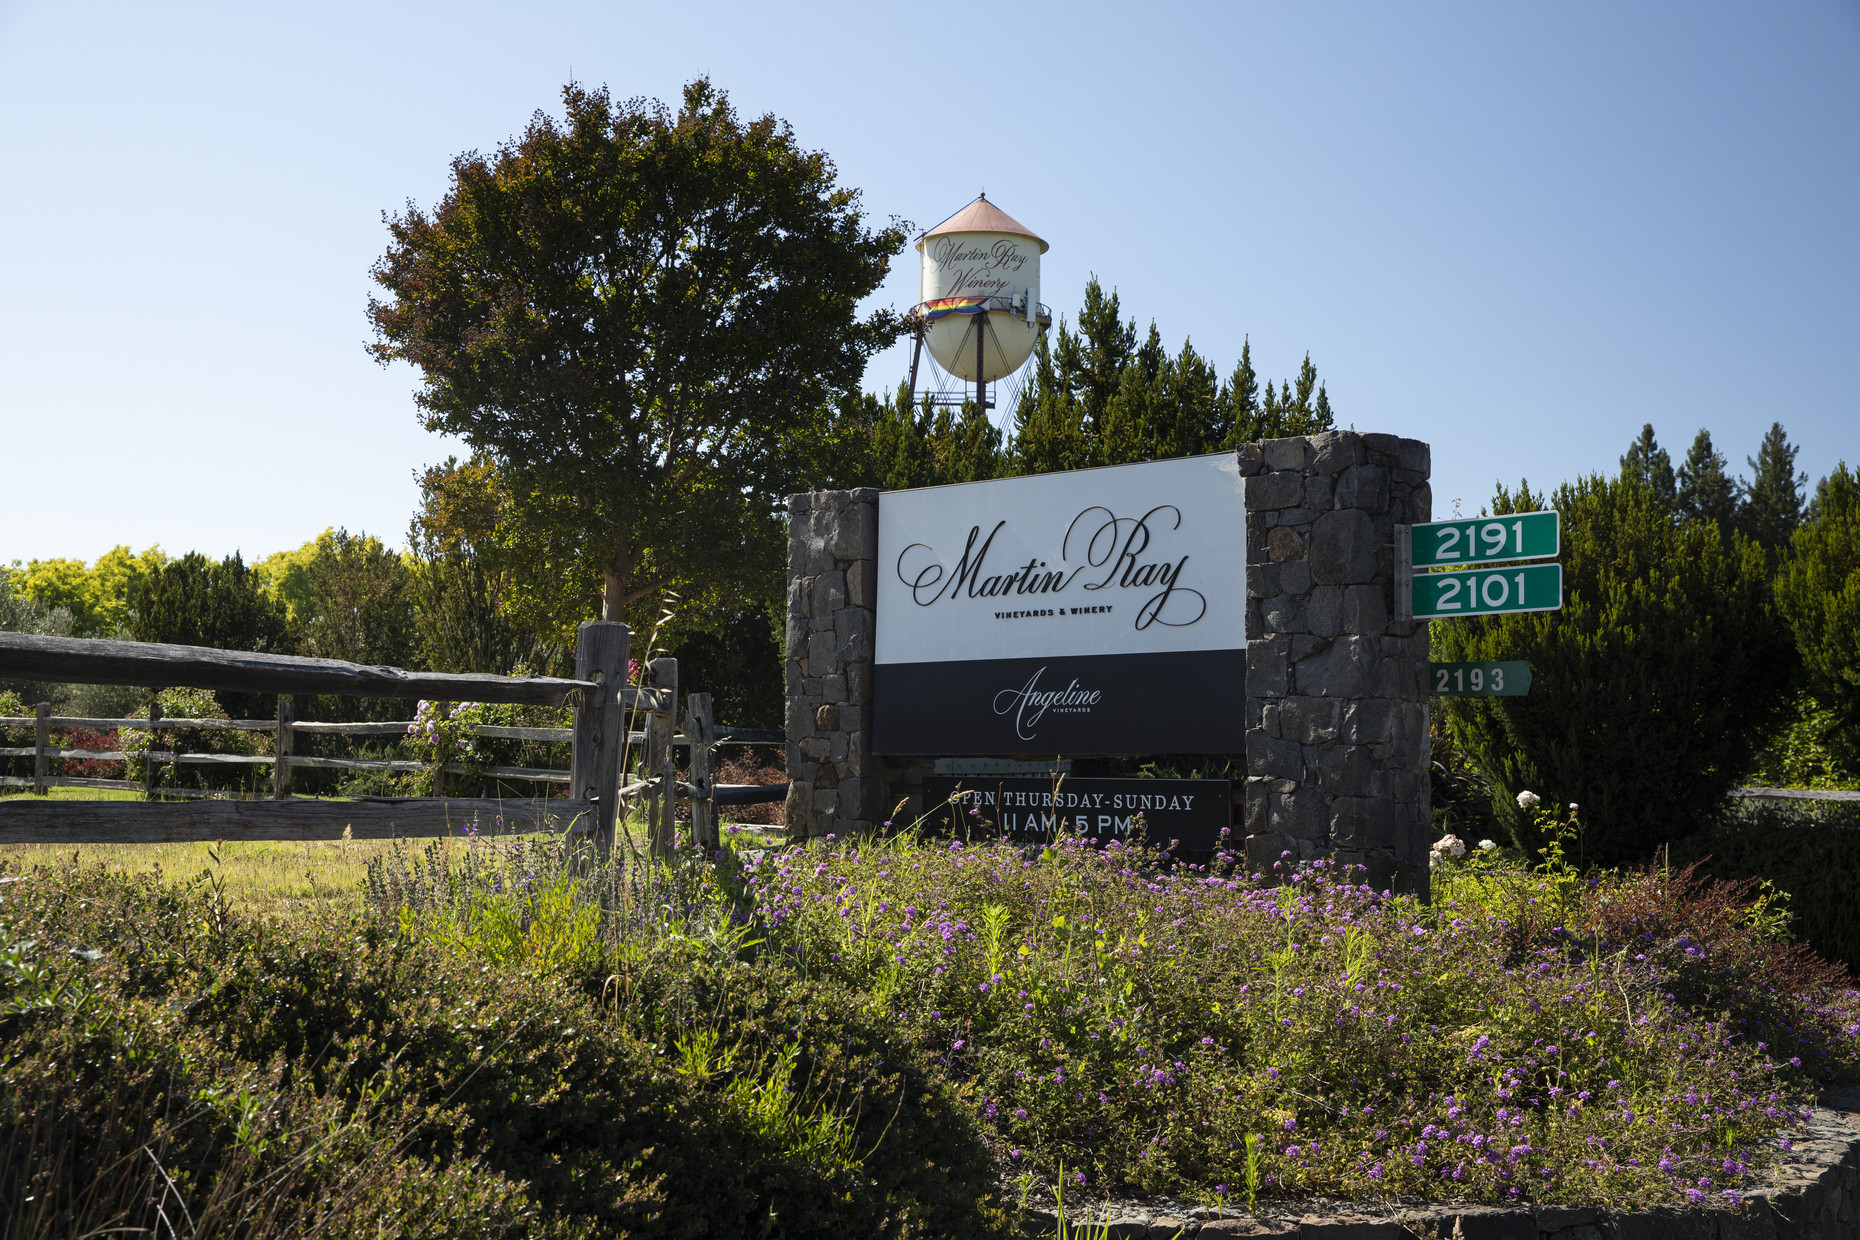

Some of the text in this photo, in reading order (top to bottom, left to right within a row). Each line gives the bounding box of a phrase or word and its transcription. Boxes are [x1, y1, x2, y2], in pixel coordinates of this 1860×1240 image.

[930, 236, 1028, 273] Martin Ray
[946, 267, 1010, 299] Winery
[1435, 520, 1523, 560] 2191
[897, 504, 1207, 631] Martin Ray
[1436, 572, 1525, 610] 2101
[994, 605, 1113, 619] VINEYARDS & WINERY
[1436, 668, 1504, 692] 2193
[993, 665, 1102, 741] Angeline
[950, 790, 995, 806] OPEN
[1024, 812, 1056, 833] AM
[1075, 815, 1089, 834] 5
[1098, 815, 1131, 836] PM
